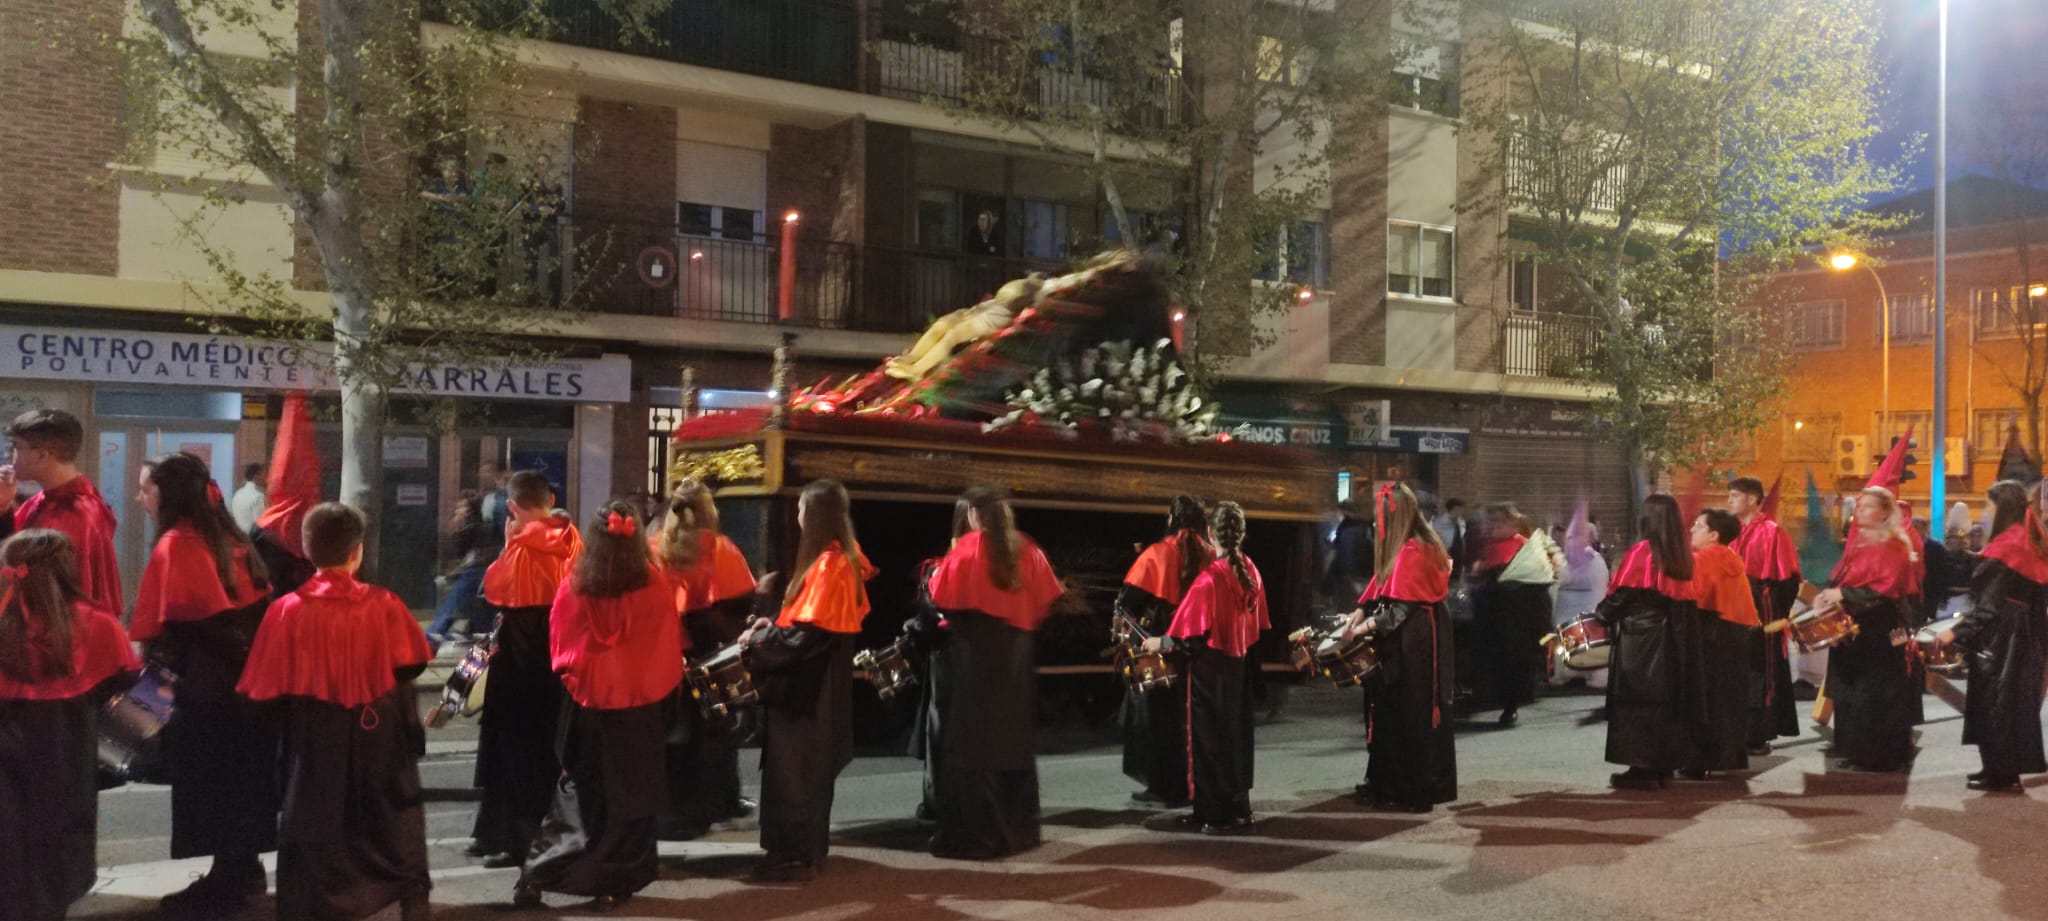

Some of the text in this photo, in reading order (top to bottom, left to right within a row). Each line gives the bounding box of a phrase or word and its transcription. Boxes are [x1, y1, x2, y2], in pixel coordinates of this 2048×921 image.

[18, 333, 298, 367] CENTRO MÉDICO
[21, 356, 297, 382] POLIVALENTE
